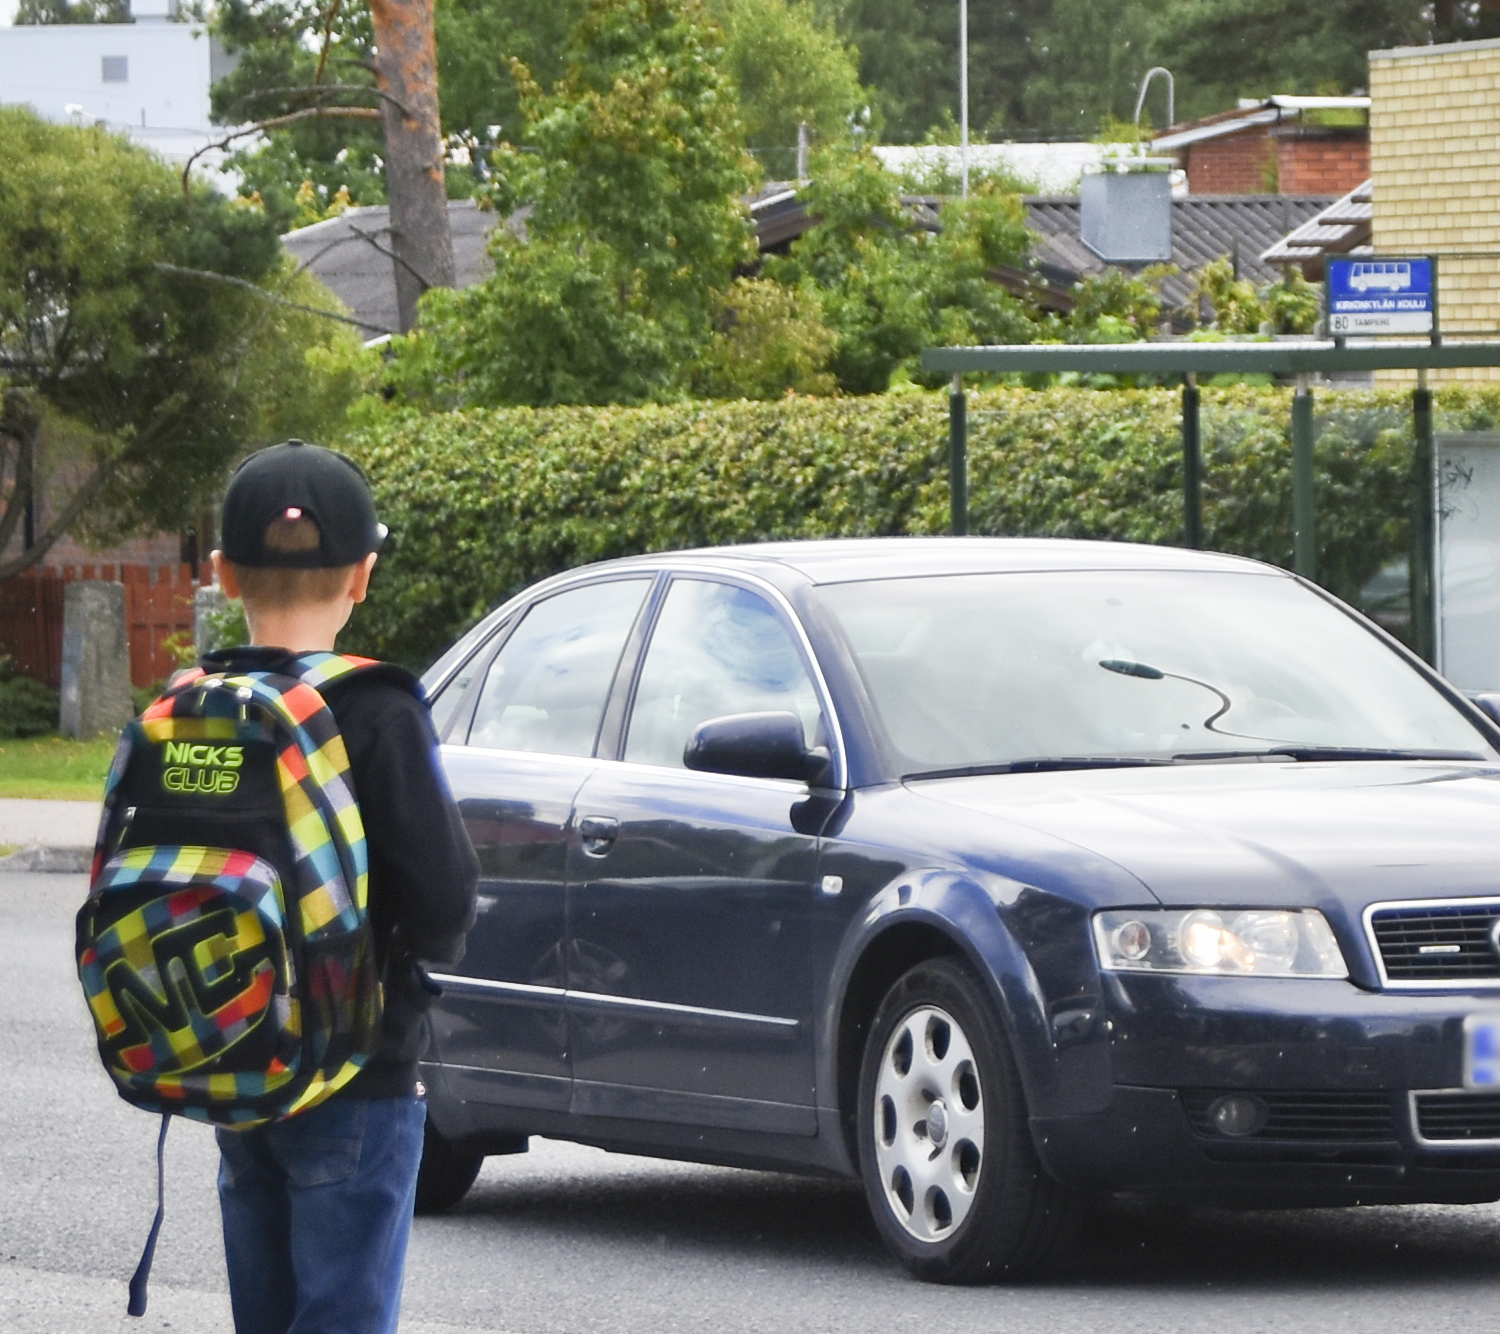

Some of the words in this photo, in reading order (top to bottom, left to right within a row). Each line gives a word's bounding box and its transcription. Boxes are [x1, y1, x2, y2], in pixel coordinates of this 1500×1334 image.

[1397, 299, 1427, 310] KOULU
[1354, 318, 1391, 326] TAMPERE
[165, 741, 244, 767] NICKS
[163, 766, 240, 793] CLUB
